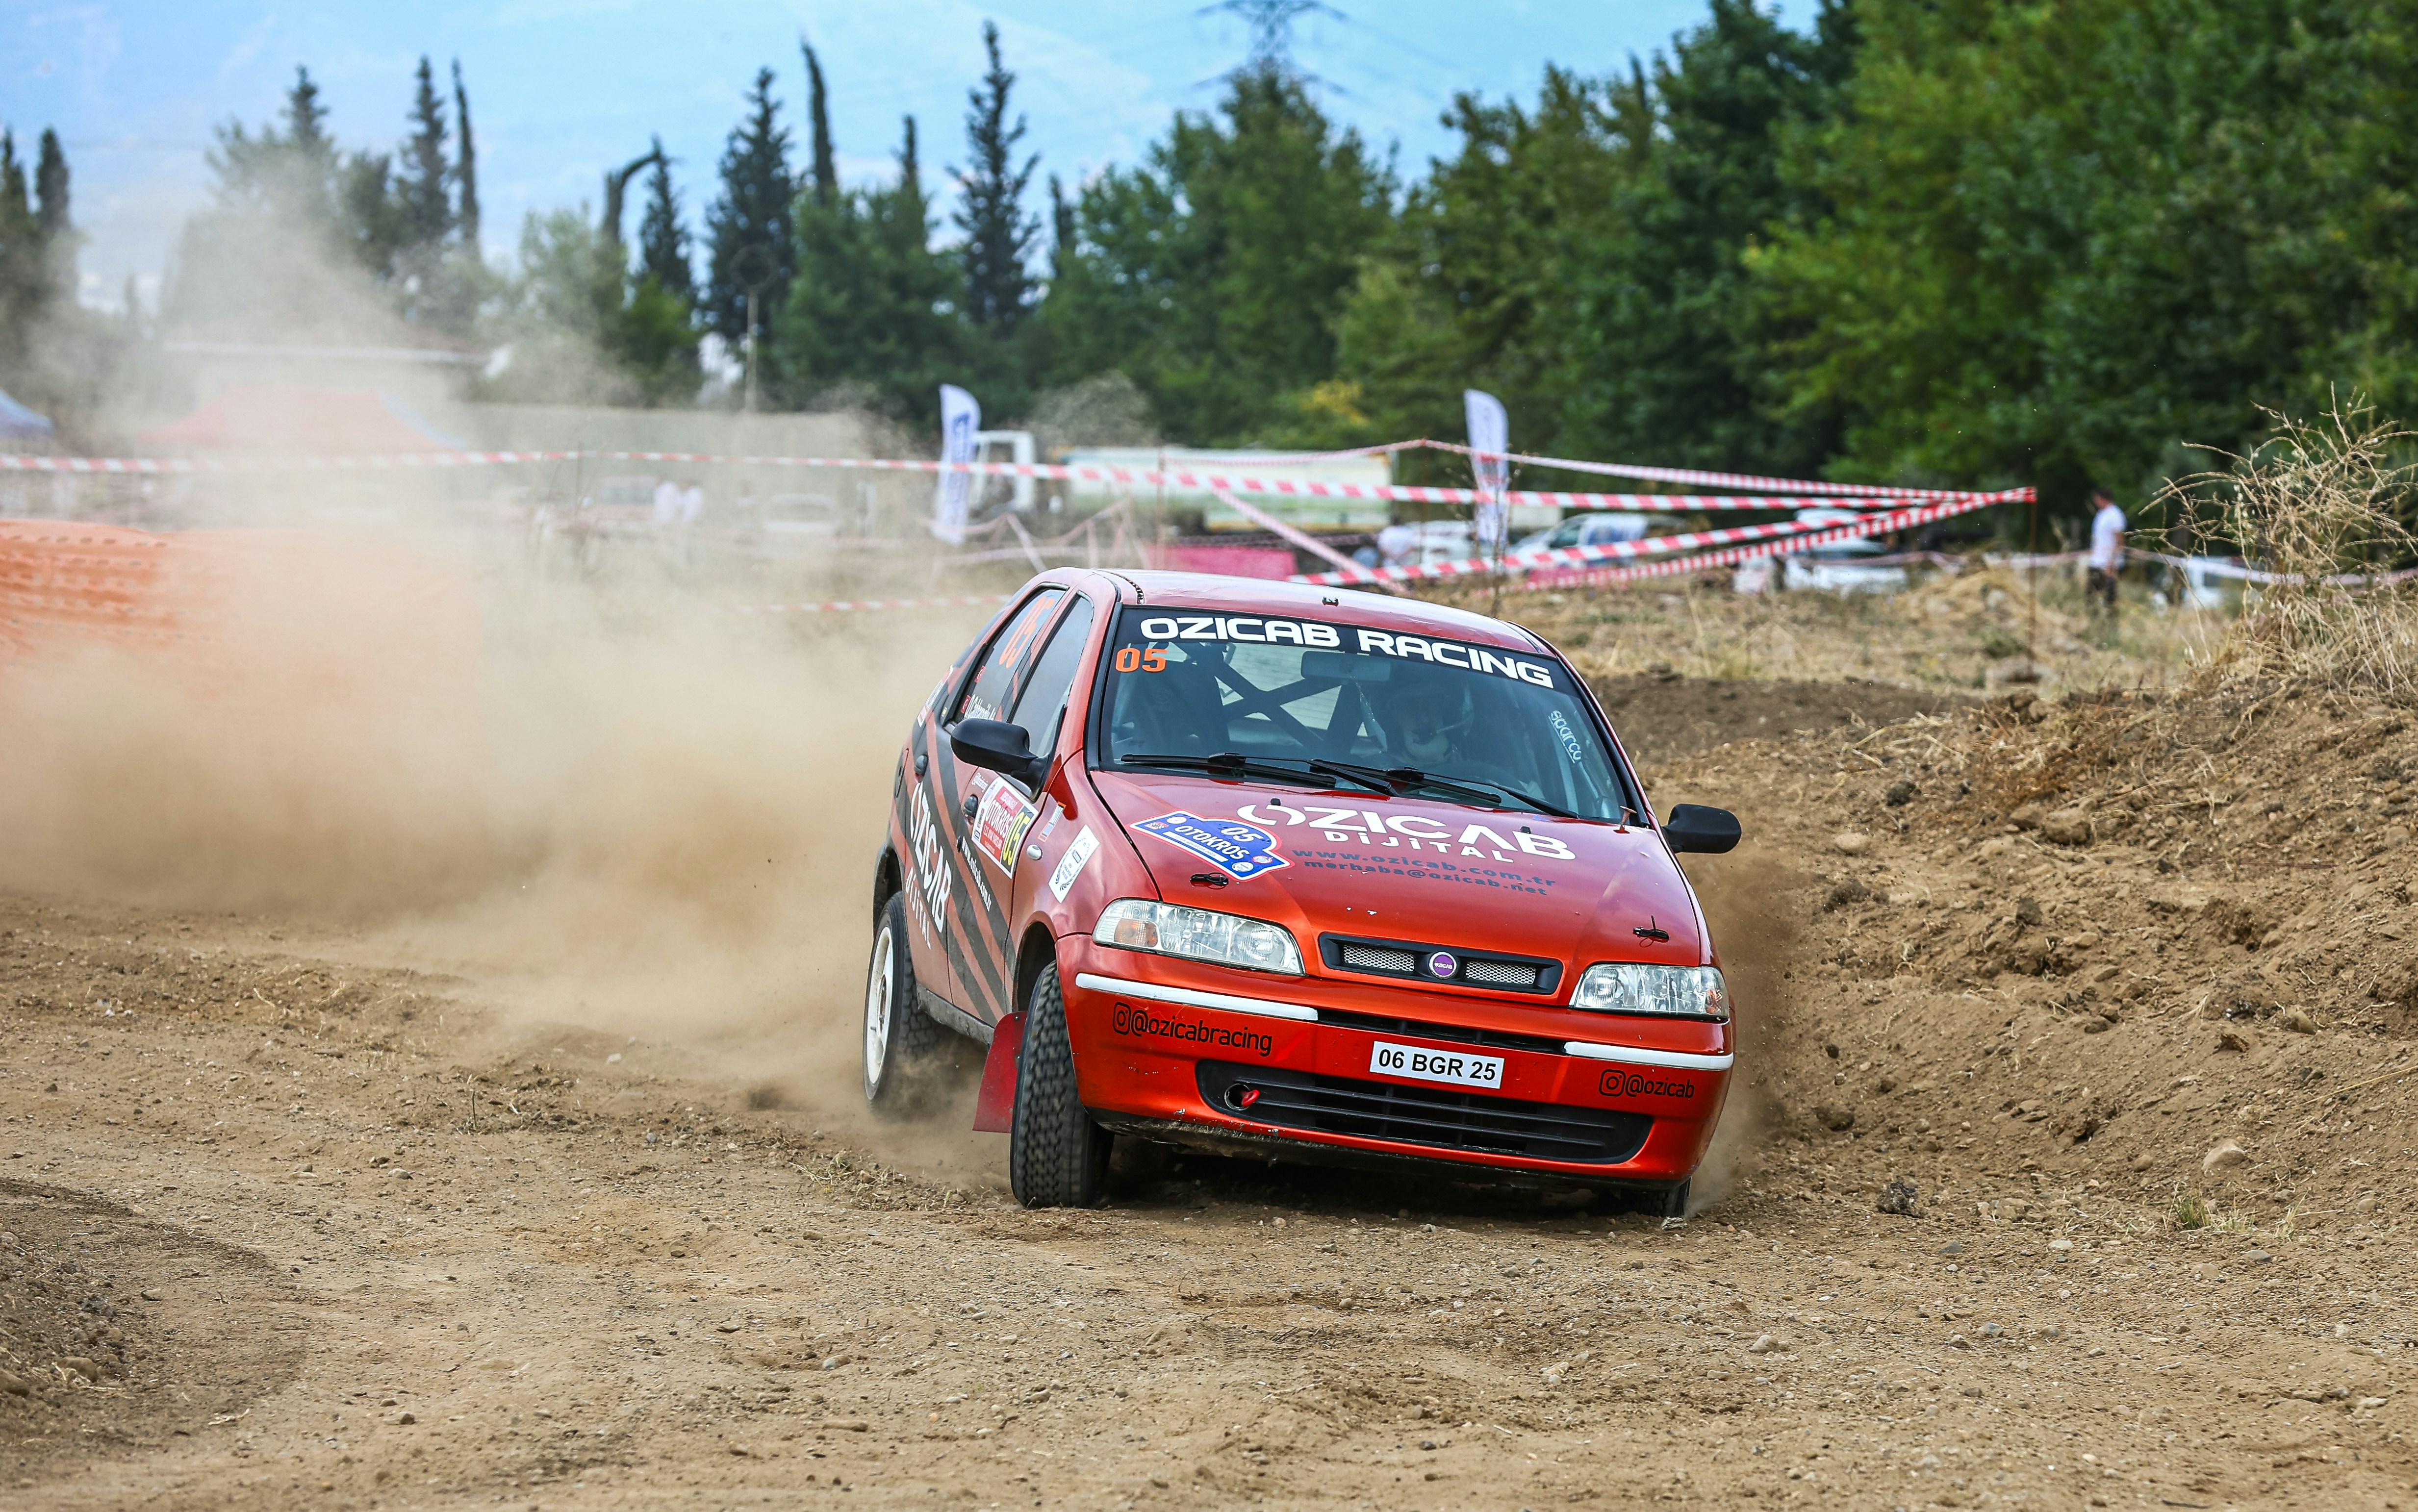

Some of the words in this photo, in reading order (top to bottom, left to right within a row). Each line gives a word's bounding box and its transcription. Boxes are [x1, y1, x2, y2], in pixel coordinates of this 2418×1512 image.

[999, 596, 1055, 669] 05
[1115, 647, 1169, 673] 05
[1140, 617, 1341, 648] OZICAB
[1356, 629, 1554, 689] RACING
[985, 799, 1014, 839] OTOKROS
[1220, 827, 1264, 842] 05
[1237, 804, 1576, 860] OZICAB
[910, 781, 952, 933] OZICAB
[1003, 811, 1030, 866] 05
[1174, 825, 1250, 859] OTOKROS
[1292, 850, 1556, 886] www.ozicab.com.tr
[1304, 861, 1547, 896] merhaba@ozicab.net
[1131, 1009, 1273, 1057] @ozicabracing
[1378, 1049, 1405, 1069] 06
[1411, 1053, 1463, 1077] BGR
[1469, 1061, 1496, 1081] 25
[1625, 1073, 1695, 1098] @ozicab
